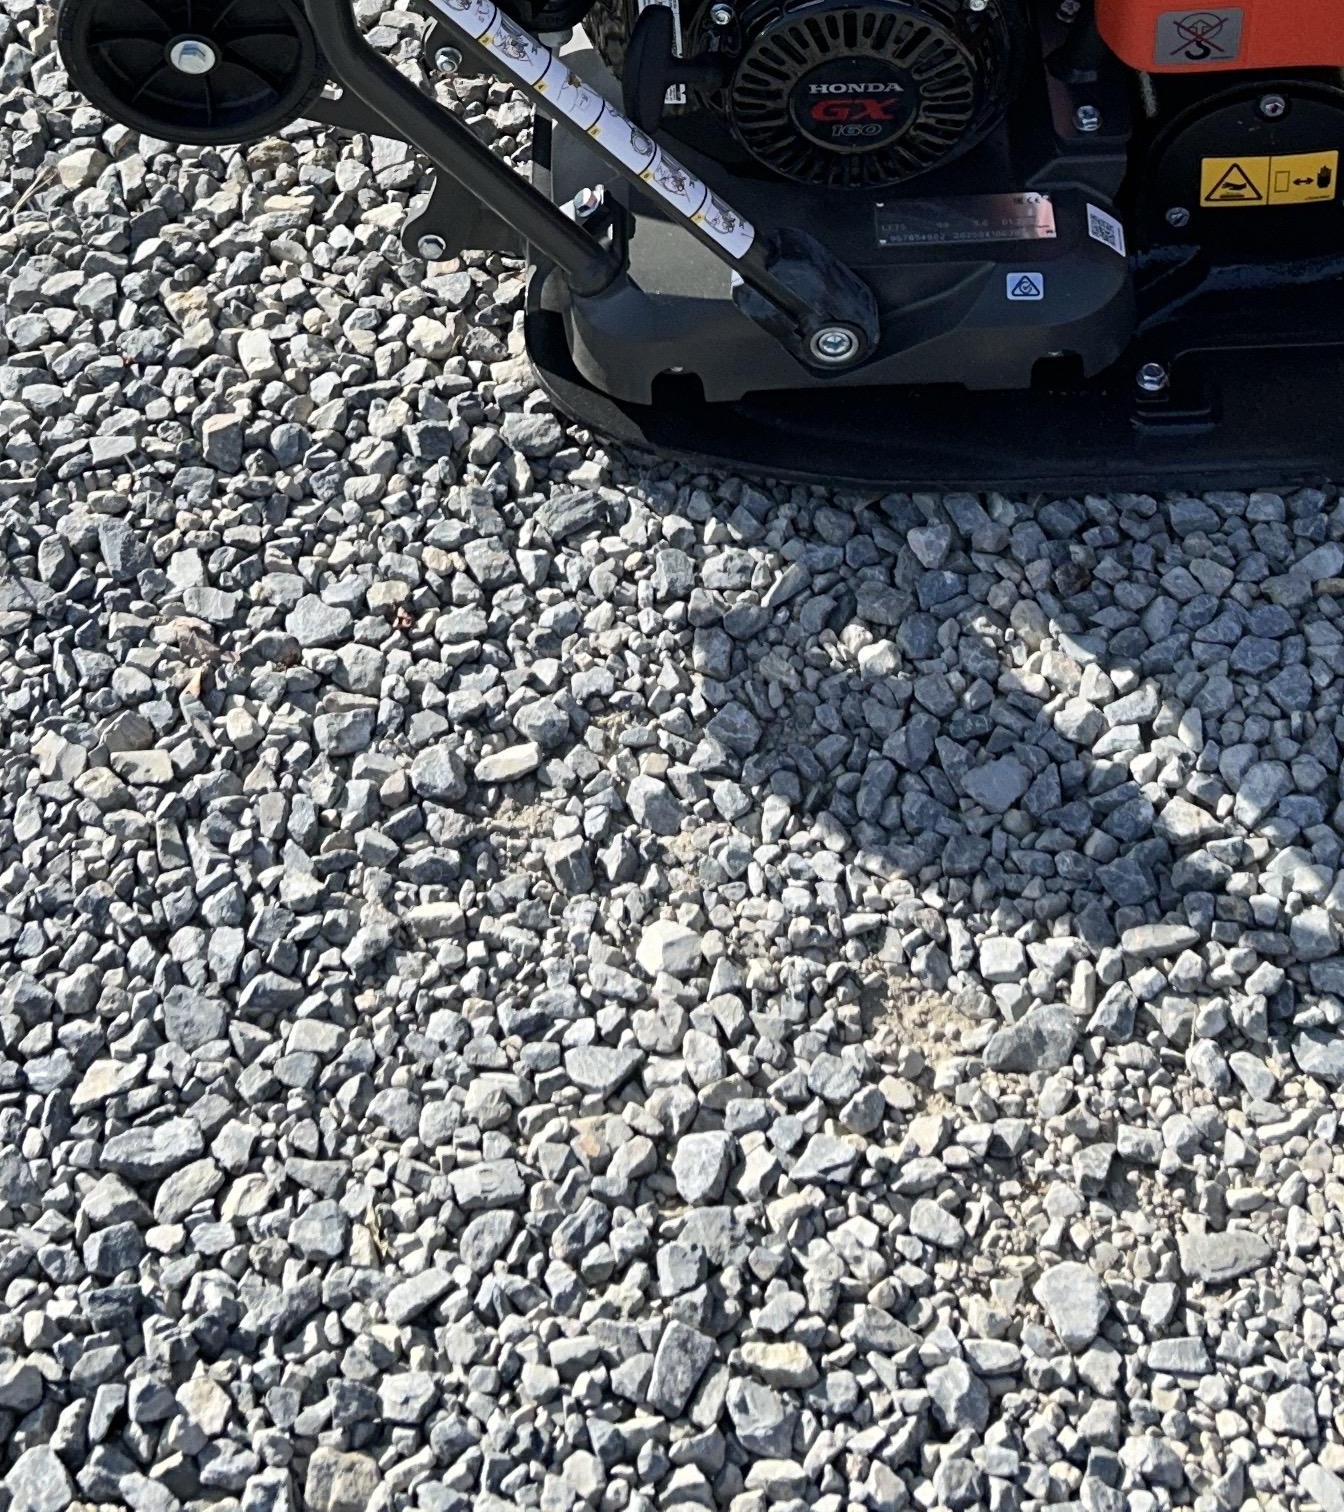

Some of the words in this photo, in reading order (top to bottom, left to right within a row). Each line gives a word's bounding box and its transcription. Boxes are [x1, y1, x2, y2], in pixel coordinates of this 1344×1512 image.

[808, 82, 905, 94] HONDA
[809, 98, 898, 122] GX
[831, 123, 883, 137] 160
